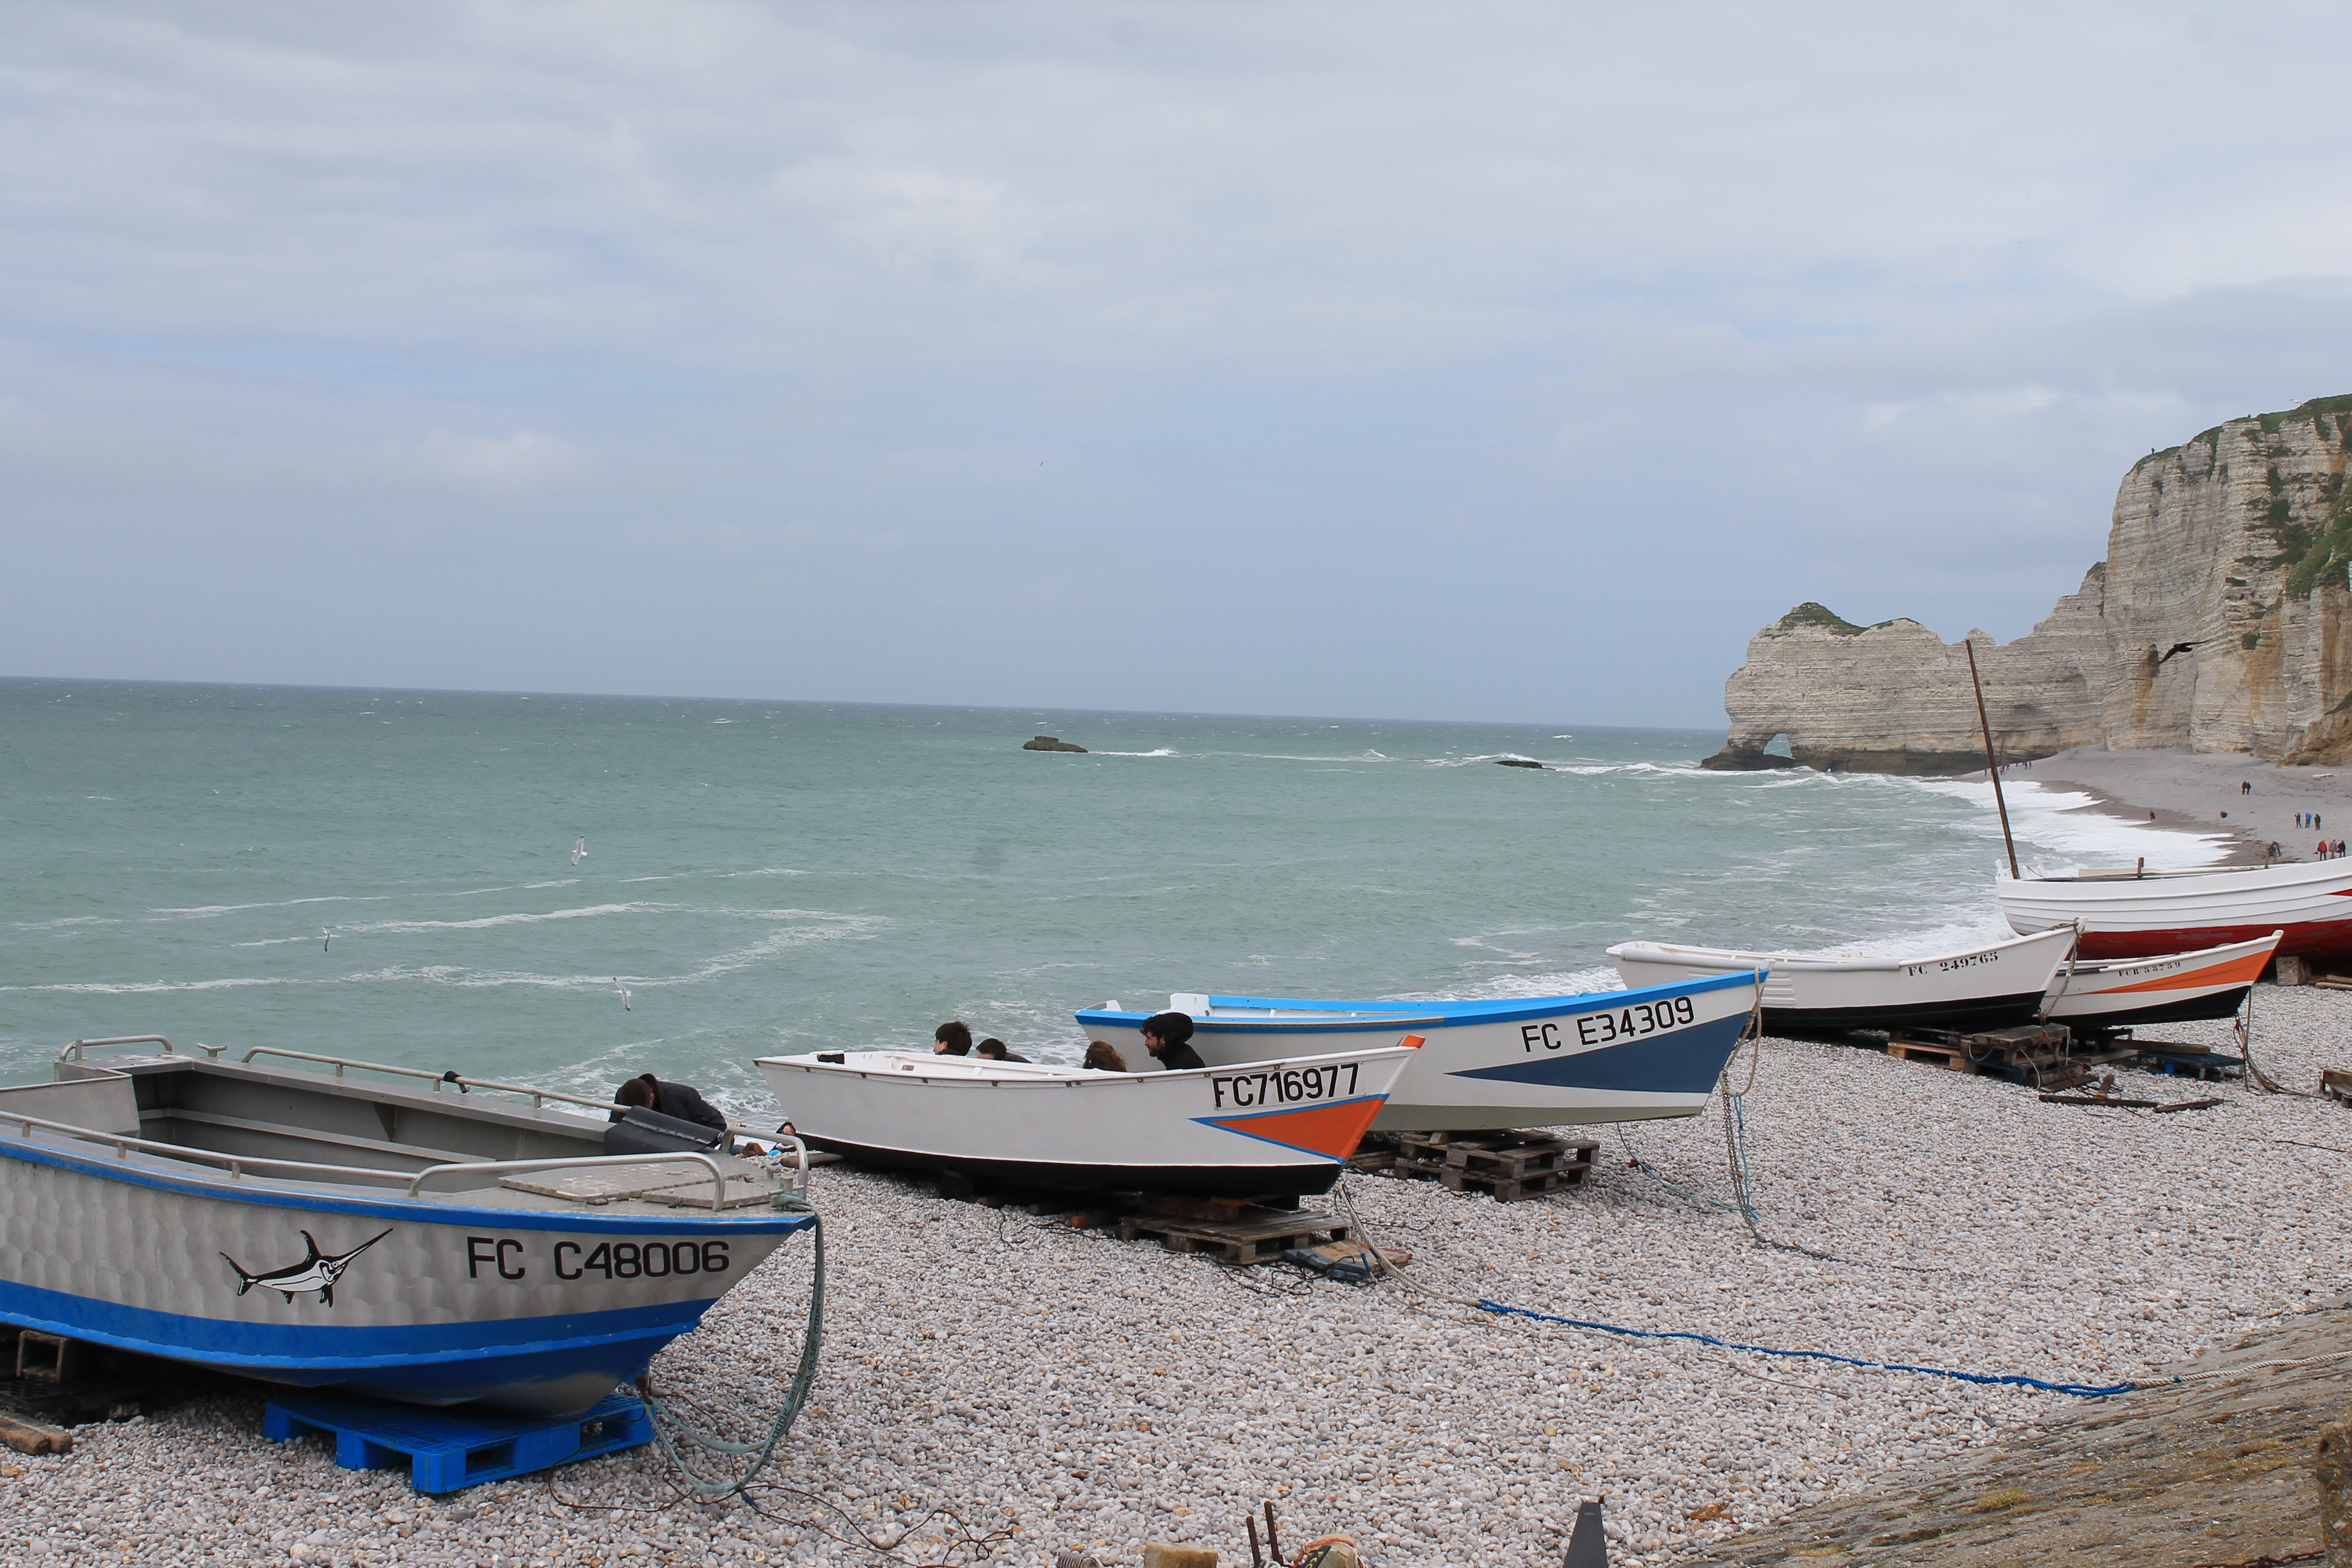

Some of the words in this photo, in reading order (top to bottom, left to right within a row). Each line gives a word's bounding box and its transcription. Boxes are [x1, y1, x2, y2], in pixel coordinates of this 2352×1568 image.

[1908, 965, 1928, 976] FC
[1940, 951, 1999, 972] 249765
[2119, 968, 2139, 977] FCB
[1521, 1023, 1561, 1053] FC
[1577, 996, 1694, 1046] E34309
[1212, 1063, 1359, 1108] FC716977
[467, 1236, 526, 1280] FC
[553, 1240, 729, 1281] C48006
[772, 1408, 789, 1439] 2000
